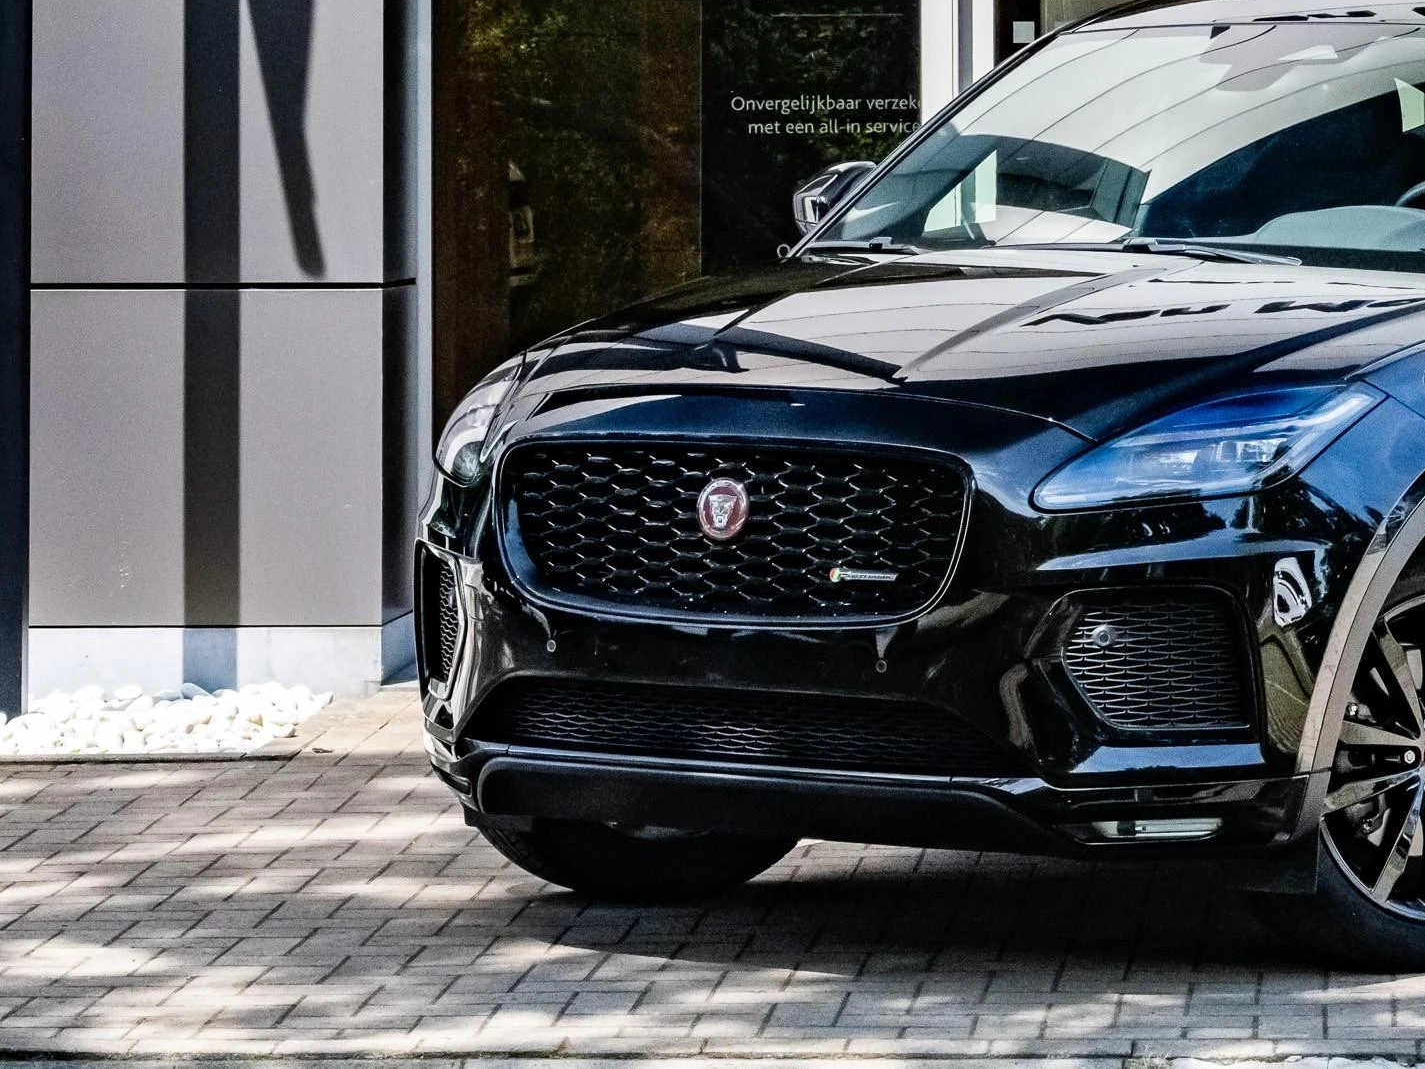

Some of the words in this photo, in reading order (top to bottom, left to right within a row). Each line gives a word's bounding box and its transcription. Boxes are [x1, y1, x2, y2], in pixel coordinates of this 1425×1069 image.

[731, 94, 862, 115] Onvergelijkbaar
[748, 119, 781, 134] met
[785, 122, 814, 134] een
[819, 118, 861, 134] all-in
